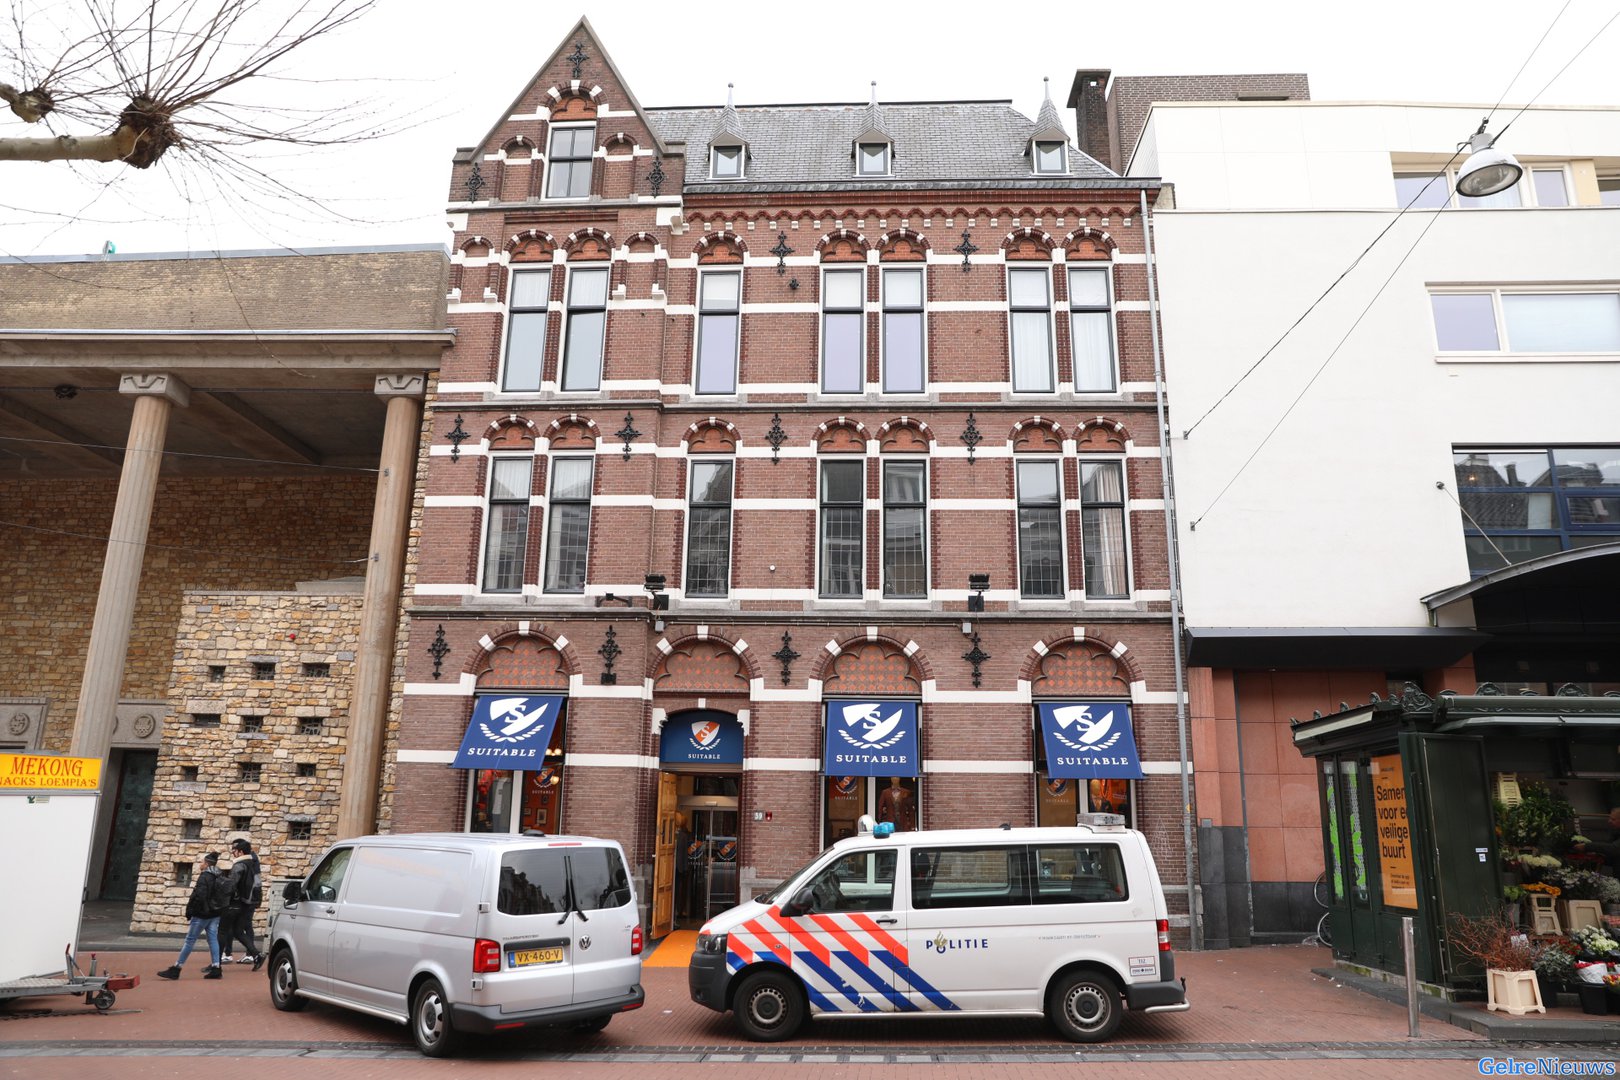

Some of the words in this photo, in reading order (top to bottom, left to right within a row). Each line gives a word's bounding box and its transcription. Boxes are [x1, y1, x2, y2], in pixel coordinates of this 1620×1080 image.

[467, 747, 537, 757] SUITABLE
[836, 754, 907, 763] SUITABLE
[10, 756, 84, 777] MEKONG
[1057, 757, 1129, 766] SUITABLE
[40, 777, 97, 787] LOEMPIA'S
[1376, 785, 1406, 801] Samen
[1378, 807, 1398, 820] voor
[1380, 823, 1408, 842] veilige
[1382, 843, 1406, 859] buurt
[926, 938, 989, 954] POLITIE
[517, 950, 560, 963] VX-460-V
